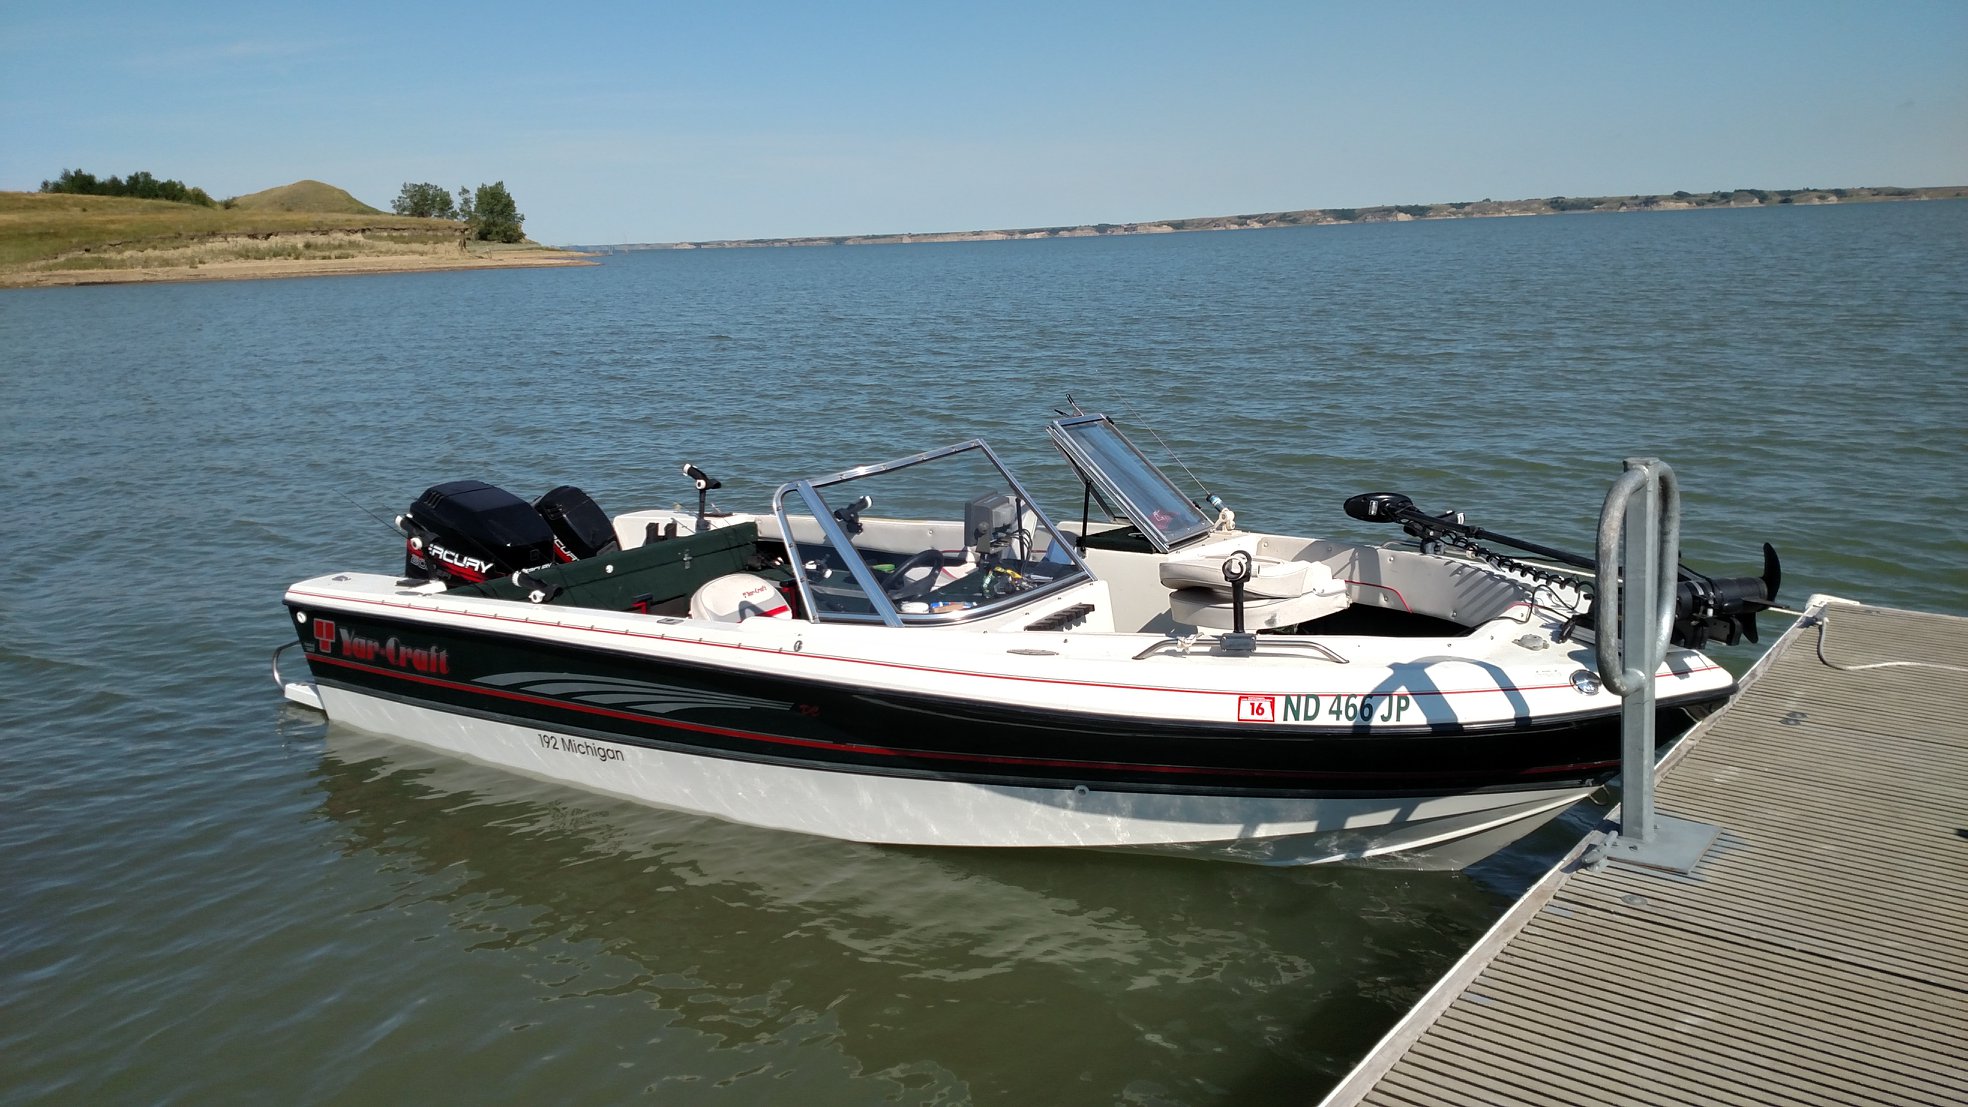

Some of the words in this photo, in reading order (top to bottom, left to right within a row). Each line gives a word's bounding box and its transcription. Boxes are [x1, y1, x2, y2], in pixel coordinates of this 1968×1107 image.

[428, 543, 494, 574] RCURY
[339, 628, 449, 675] Yar-Craft
[1250, 702, 1265, 716] 16
[1283, 694, 1321, 722] ND
[1328, 694, 1373, 722] 466
[1380, 694, 1410, 722] JP
[538, 734, 559, 750] 192
[561, 737, 625, 761] Michigan
